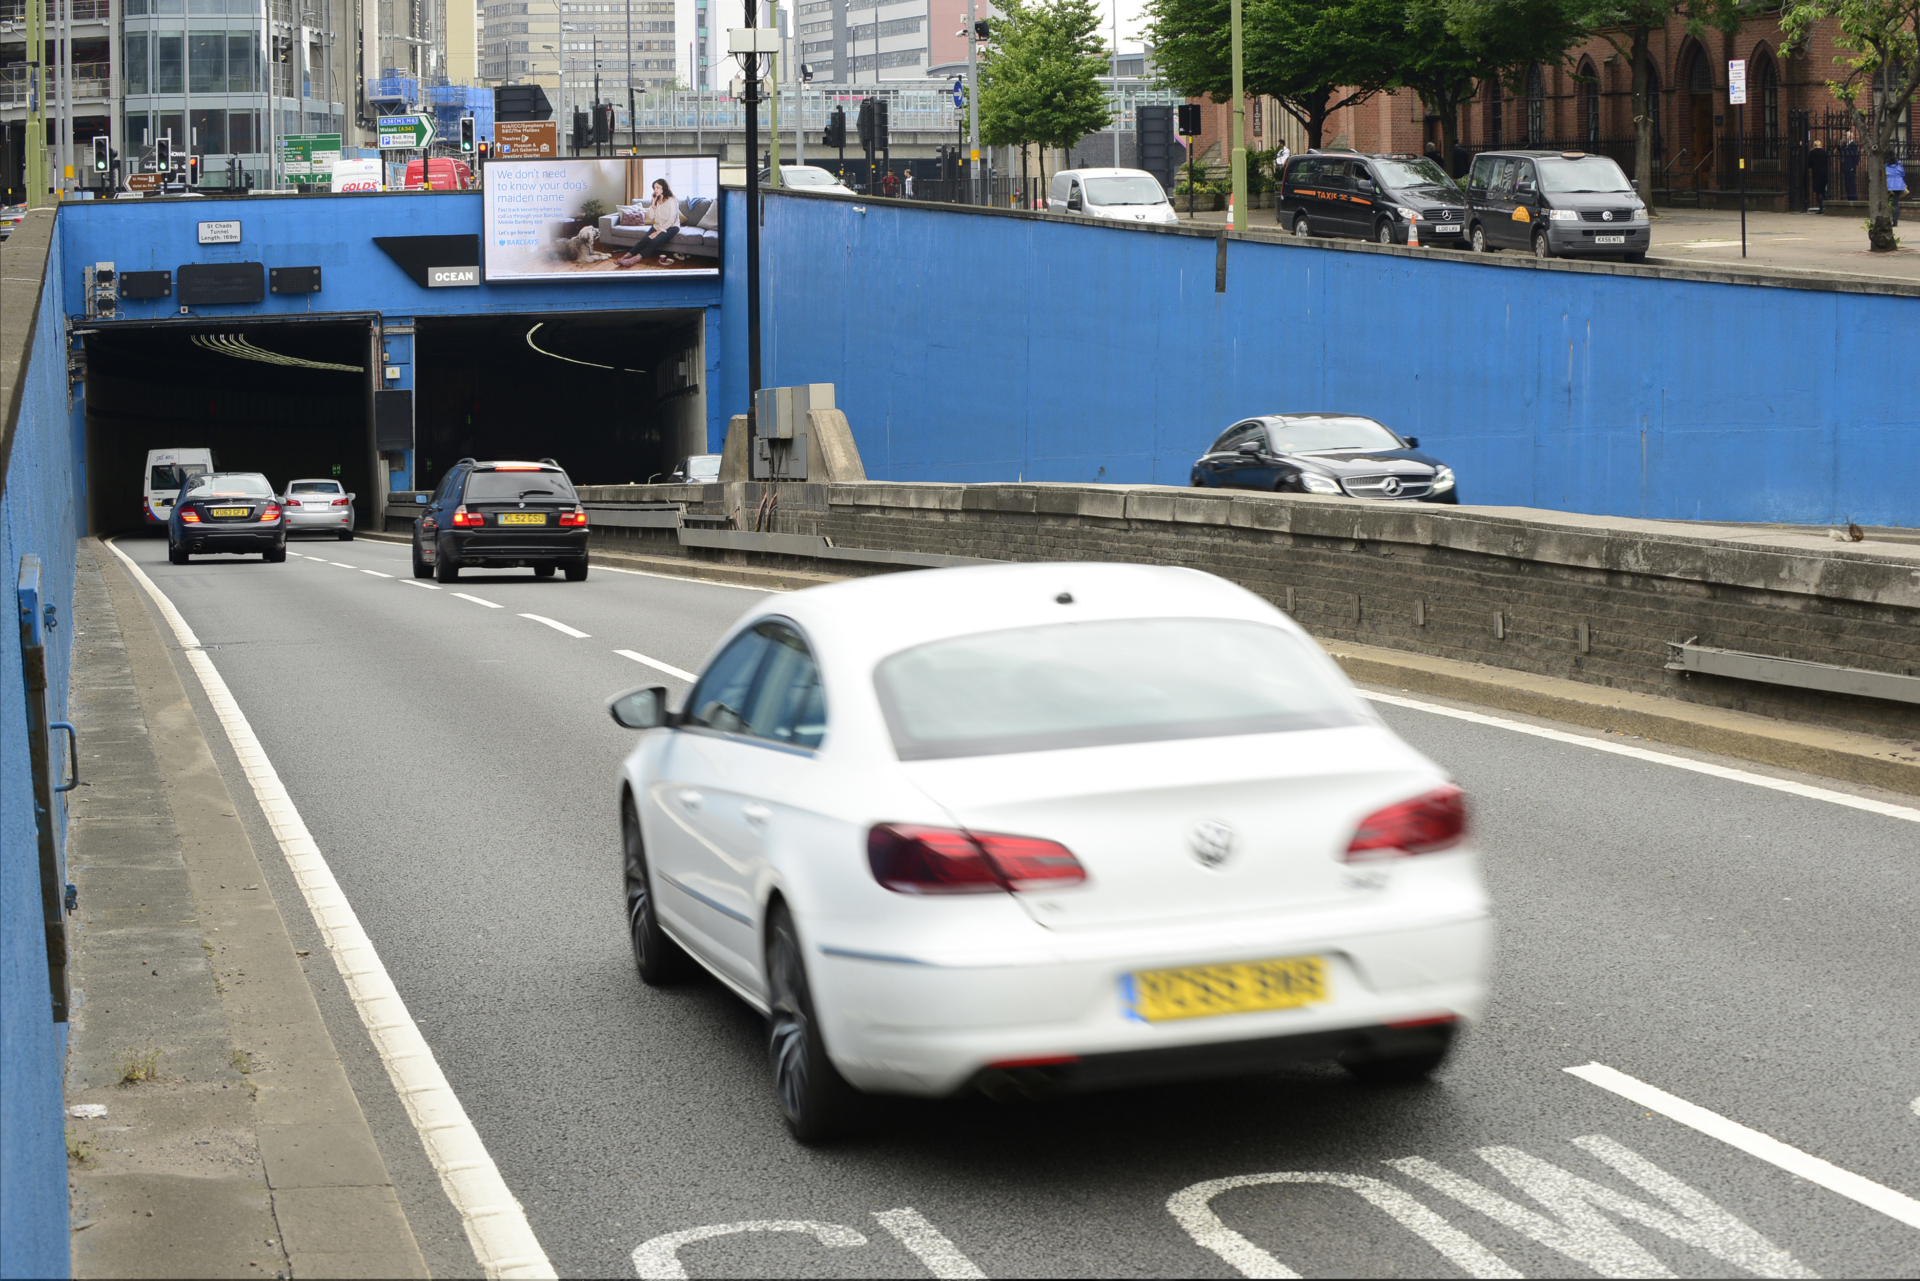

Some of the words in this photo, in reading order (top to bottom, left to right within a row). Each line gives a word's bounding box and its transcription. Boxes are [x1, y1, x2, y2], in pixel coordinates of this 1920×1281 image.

[497, 170, 513, 179] We
[515, 168, 539, 179] don't
[542, 168, 566, 178] need
[342, 181, 378, 192] GOLDS
[498, 183, 508, 191] to
[510, 181, 537, 191] know
[539, 182, 560, 192] your
[563, 180, 588, 192] dog's
[498, 193, 534, 203] maiden
[536, 194, 564, 202] name
[435, 272, 474, 282] OCEAN
[504, 514, 526, 523] KL52
[528, 514, 544, 522] GSU
